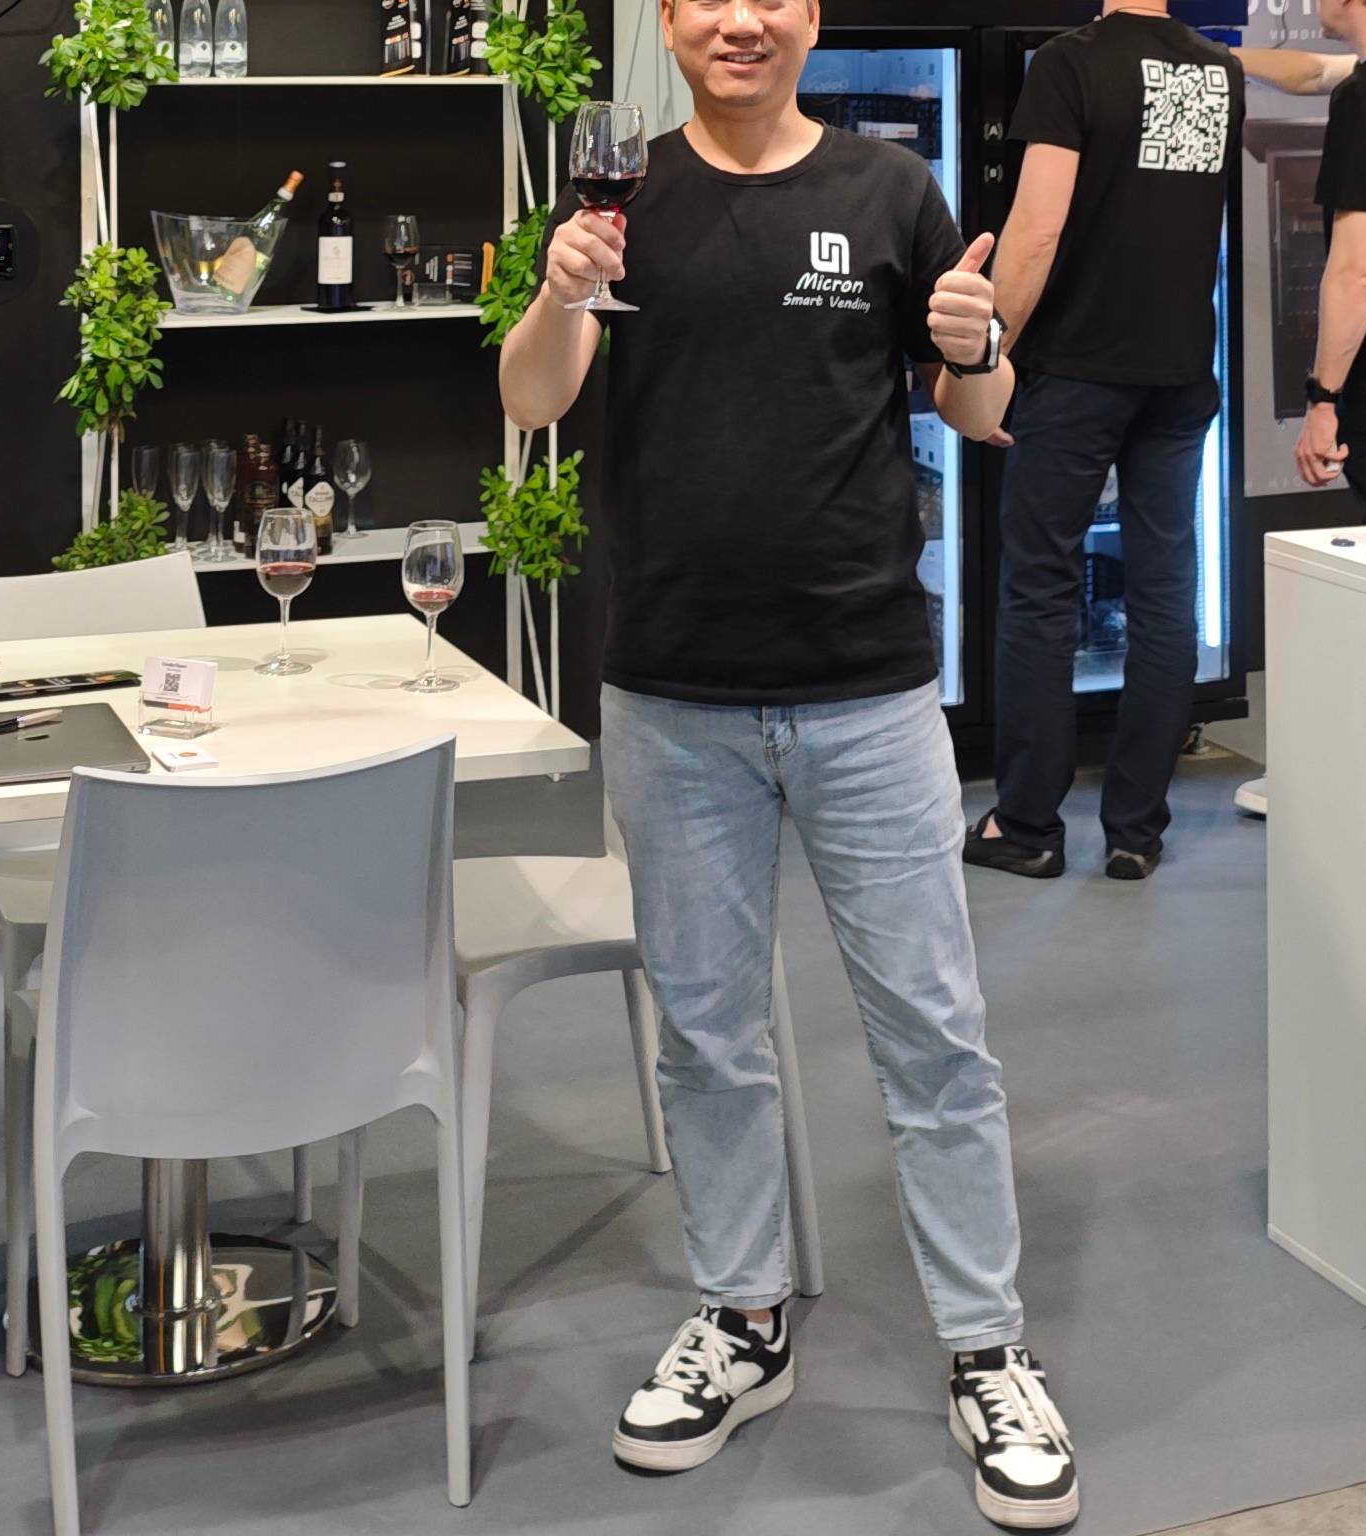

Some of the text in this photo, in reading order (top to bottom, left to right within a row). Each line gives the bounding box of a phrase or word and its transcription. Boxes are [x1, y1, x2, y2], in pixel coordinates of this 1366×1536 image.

[795, 271, 864, 294] Micron
[782, 292, 871, 314] Smart Vending
